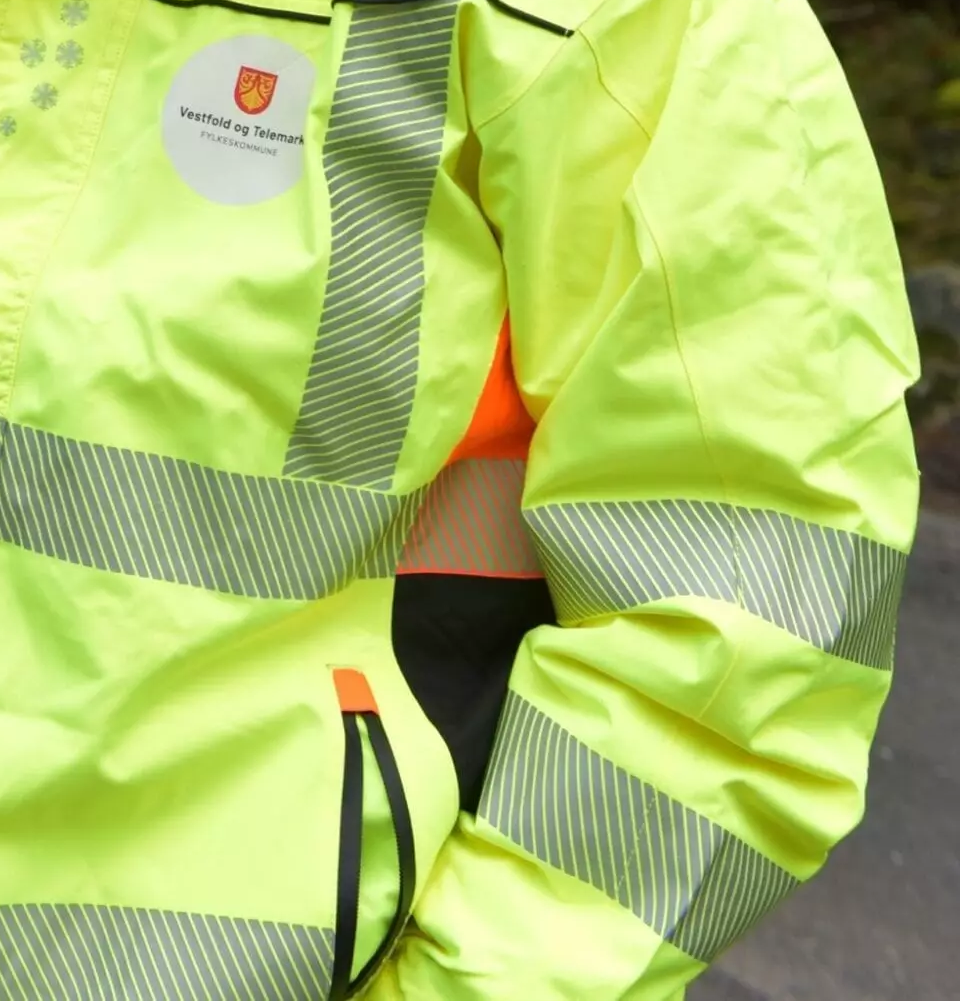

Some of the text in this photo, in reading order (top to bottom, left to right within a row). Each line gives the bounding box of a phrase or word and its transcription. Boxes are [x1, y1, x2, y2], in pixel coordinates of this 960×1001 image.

[180, 106, 304, 146] Vestfold og Telemark
[200, 130, 278, 157] FYLKESKOMMUNE
